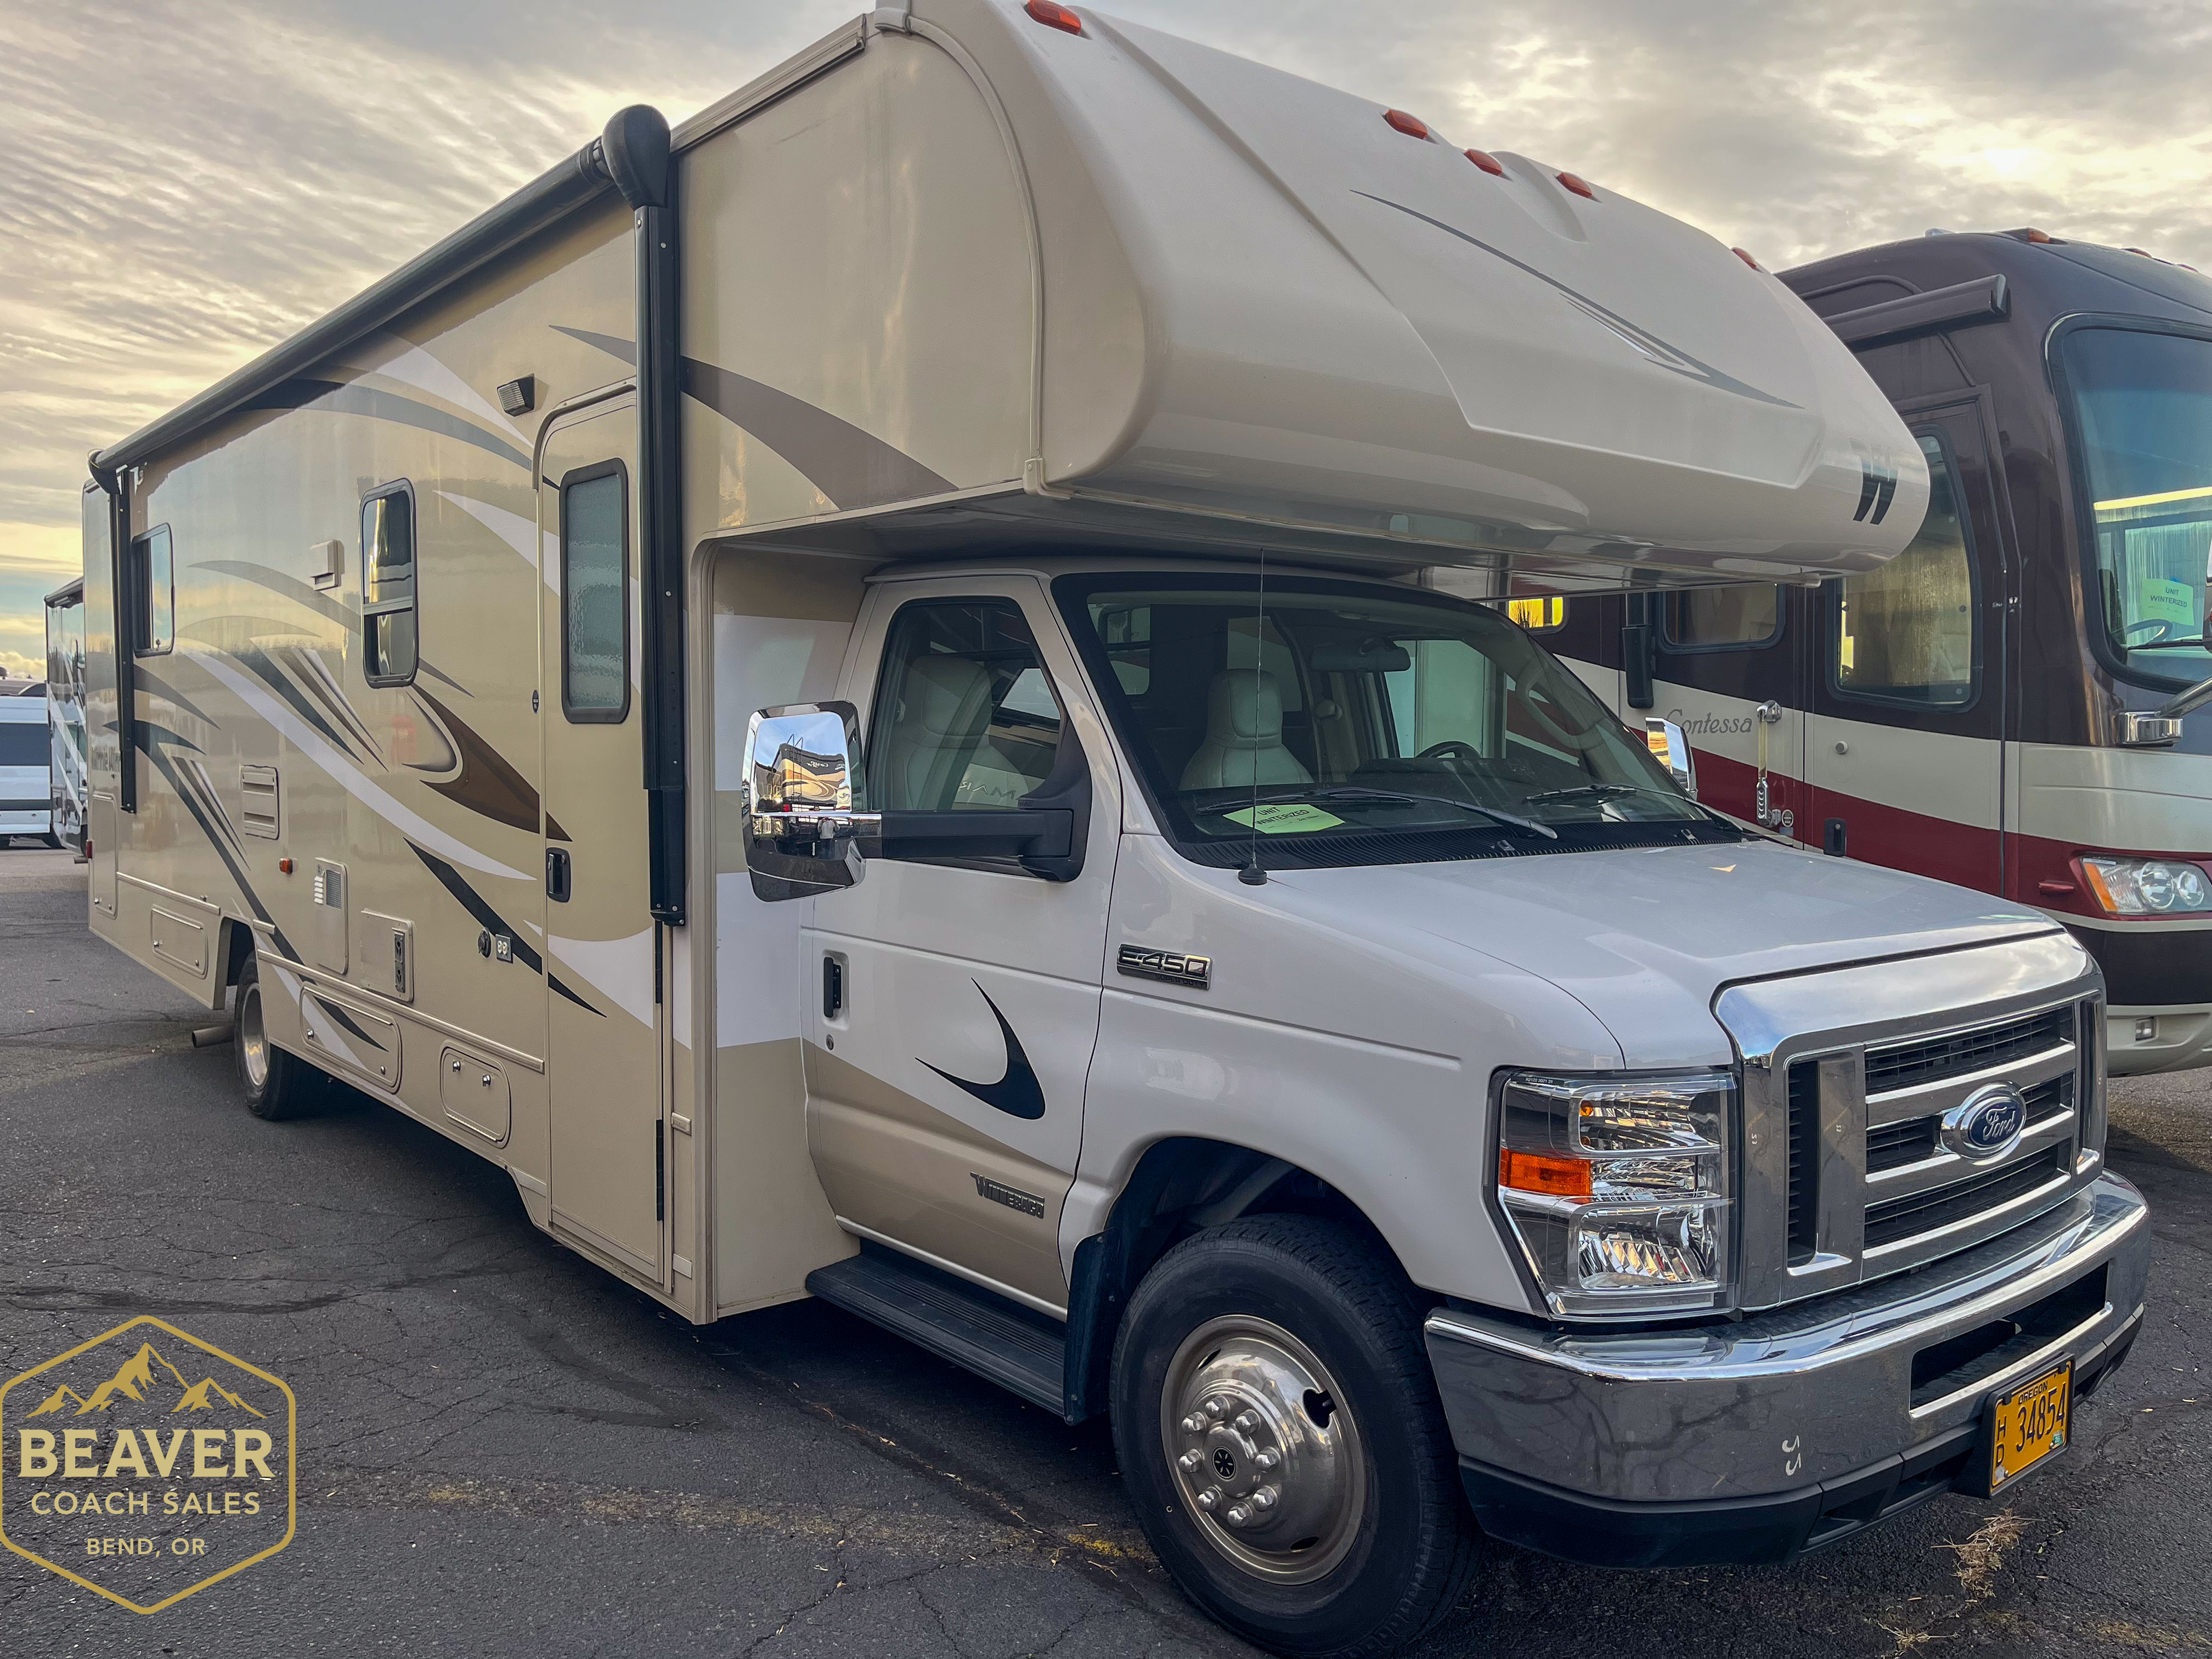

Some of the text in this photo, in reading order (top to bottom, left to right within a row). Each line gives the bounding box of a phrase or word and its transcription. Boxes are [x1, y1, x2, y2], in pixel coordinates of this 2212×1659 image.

[2165, 587, 2179, 595] UNIT
[2151, 595, 2187, 607] WINTERIZED
[1255, 809, 1310, 825] WINTERIZED
[1257, 806, 1280, 815] UNIT
[1155, 974, 1205, 986] SUPER DUTY
[1983, 1106, 2016, 1141] Ford
[969, 1171, 1045, 1219] WINNEBAGO
[2018, 1380, 2048, 1404] OREGON
[2016, 1382, 2066, 1452] 34854
